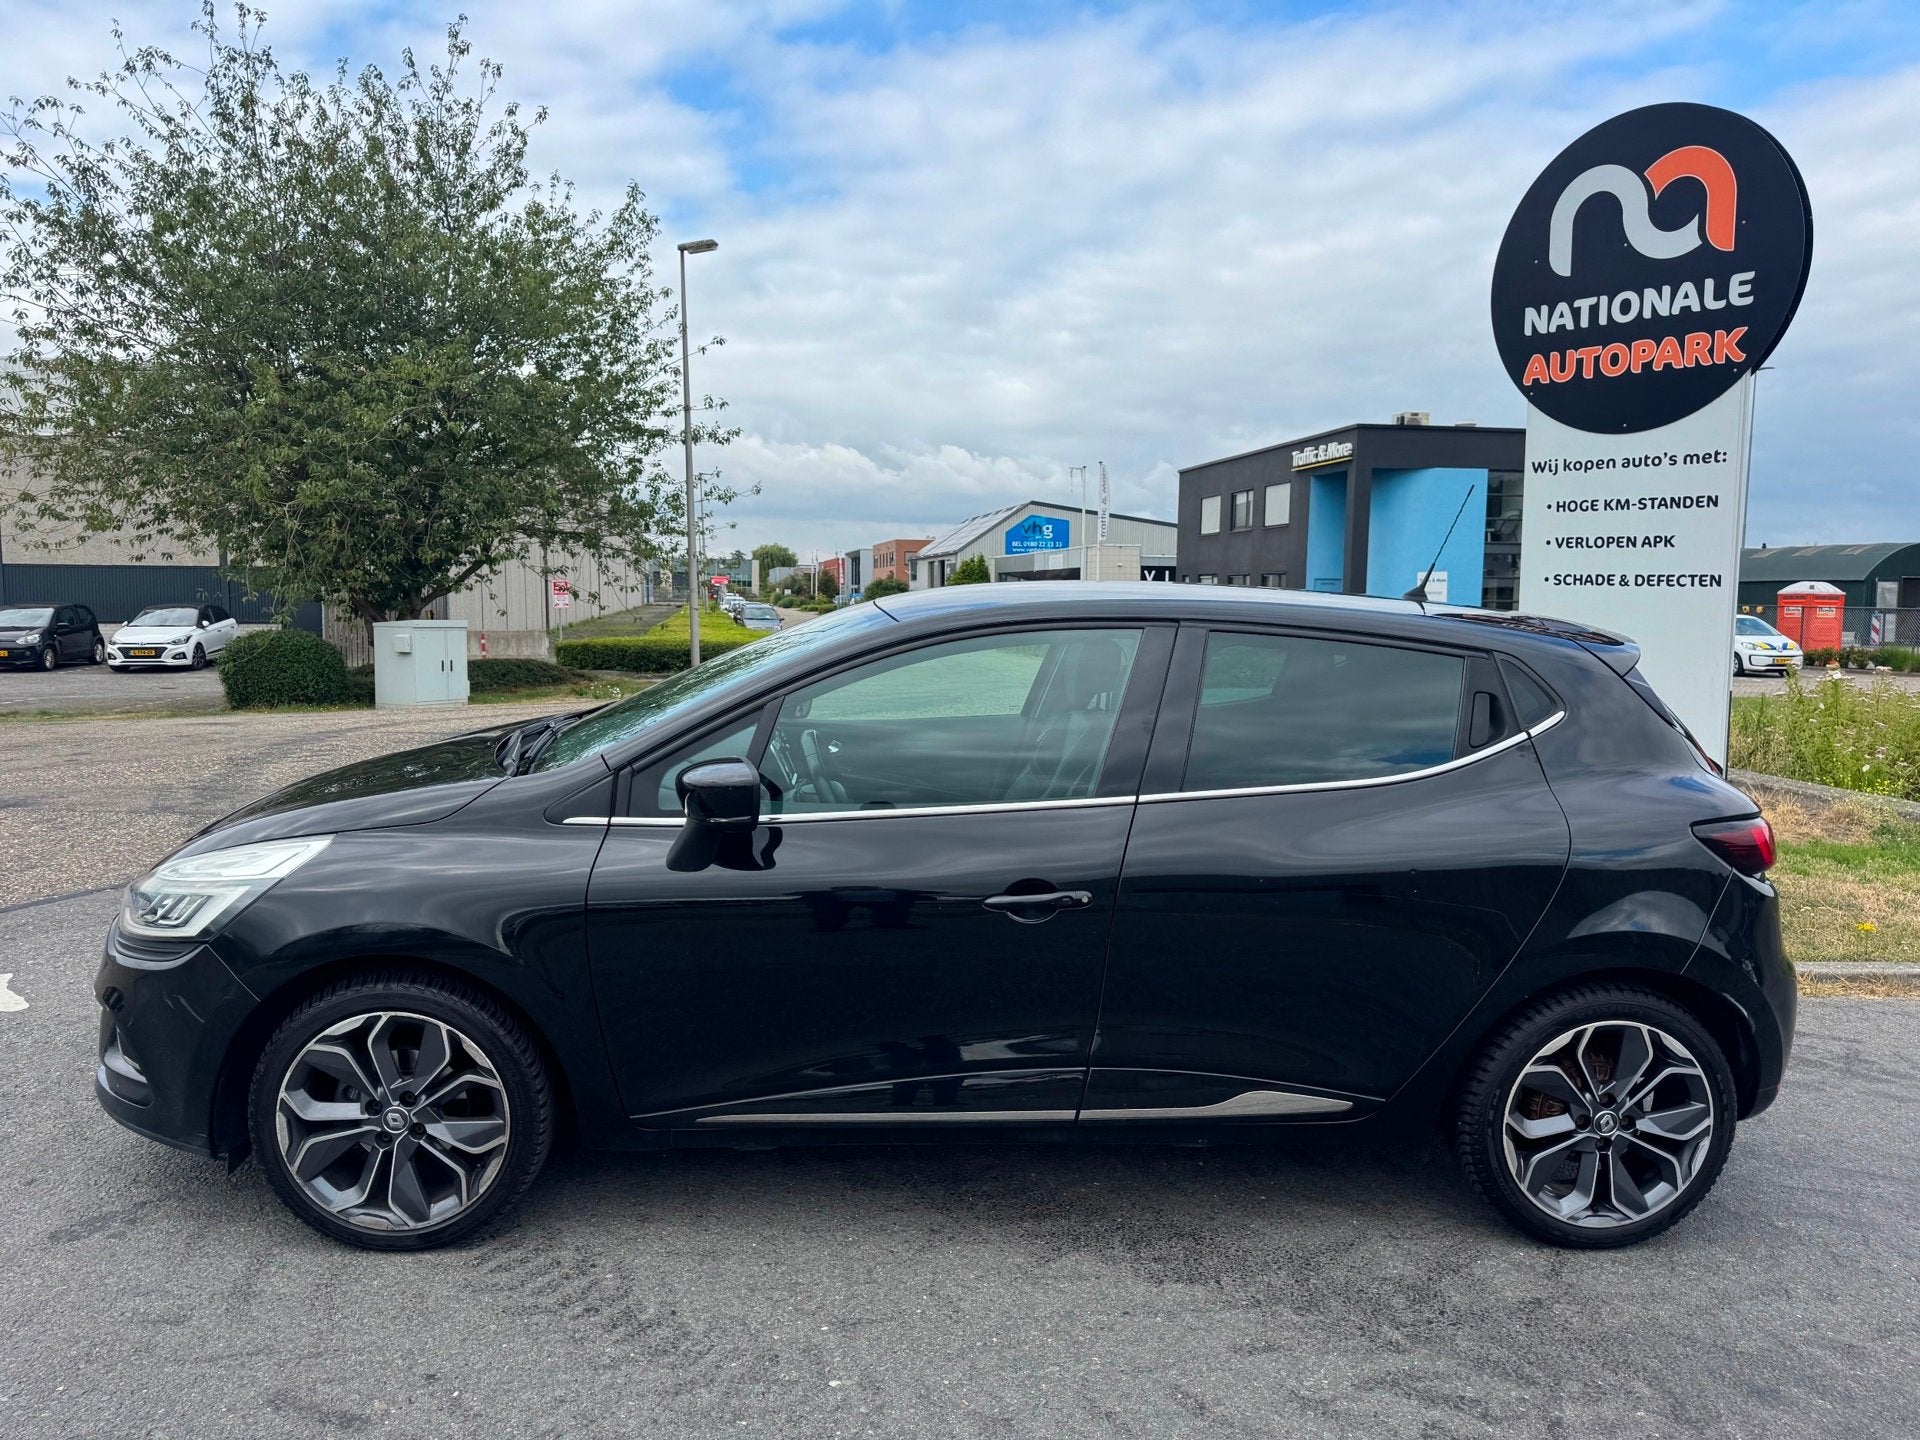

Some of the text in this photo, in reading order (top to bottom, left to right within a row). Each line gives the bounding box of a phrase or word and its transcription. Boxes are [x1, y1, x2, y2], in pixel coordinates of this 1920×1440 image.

[1523, 271, 1756, 336] NATIONALE
[1522, 326, 1749, 385] AUTOPARK
[1531, 449, 1728, 476] Wij kopen auto's met:
[1556, 494, 1719, 513] HOGE KM-STANDEN
[1022, 521, 1053, 539] vhg
[1555, 535, 1676, 549] VERLOPEN APK
[1553, 574, 1722, 588] SCHADE & DEFECTEN
